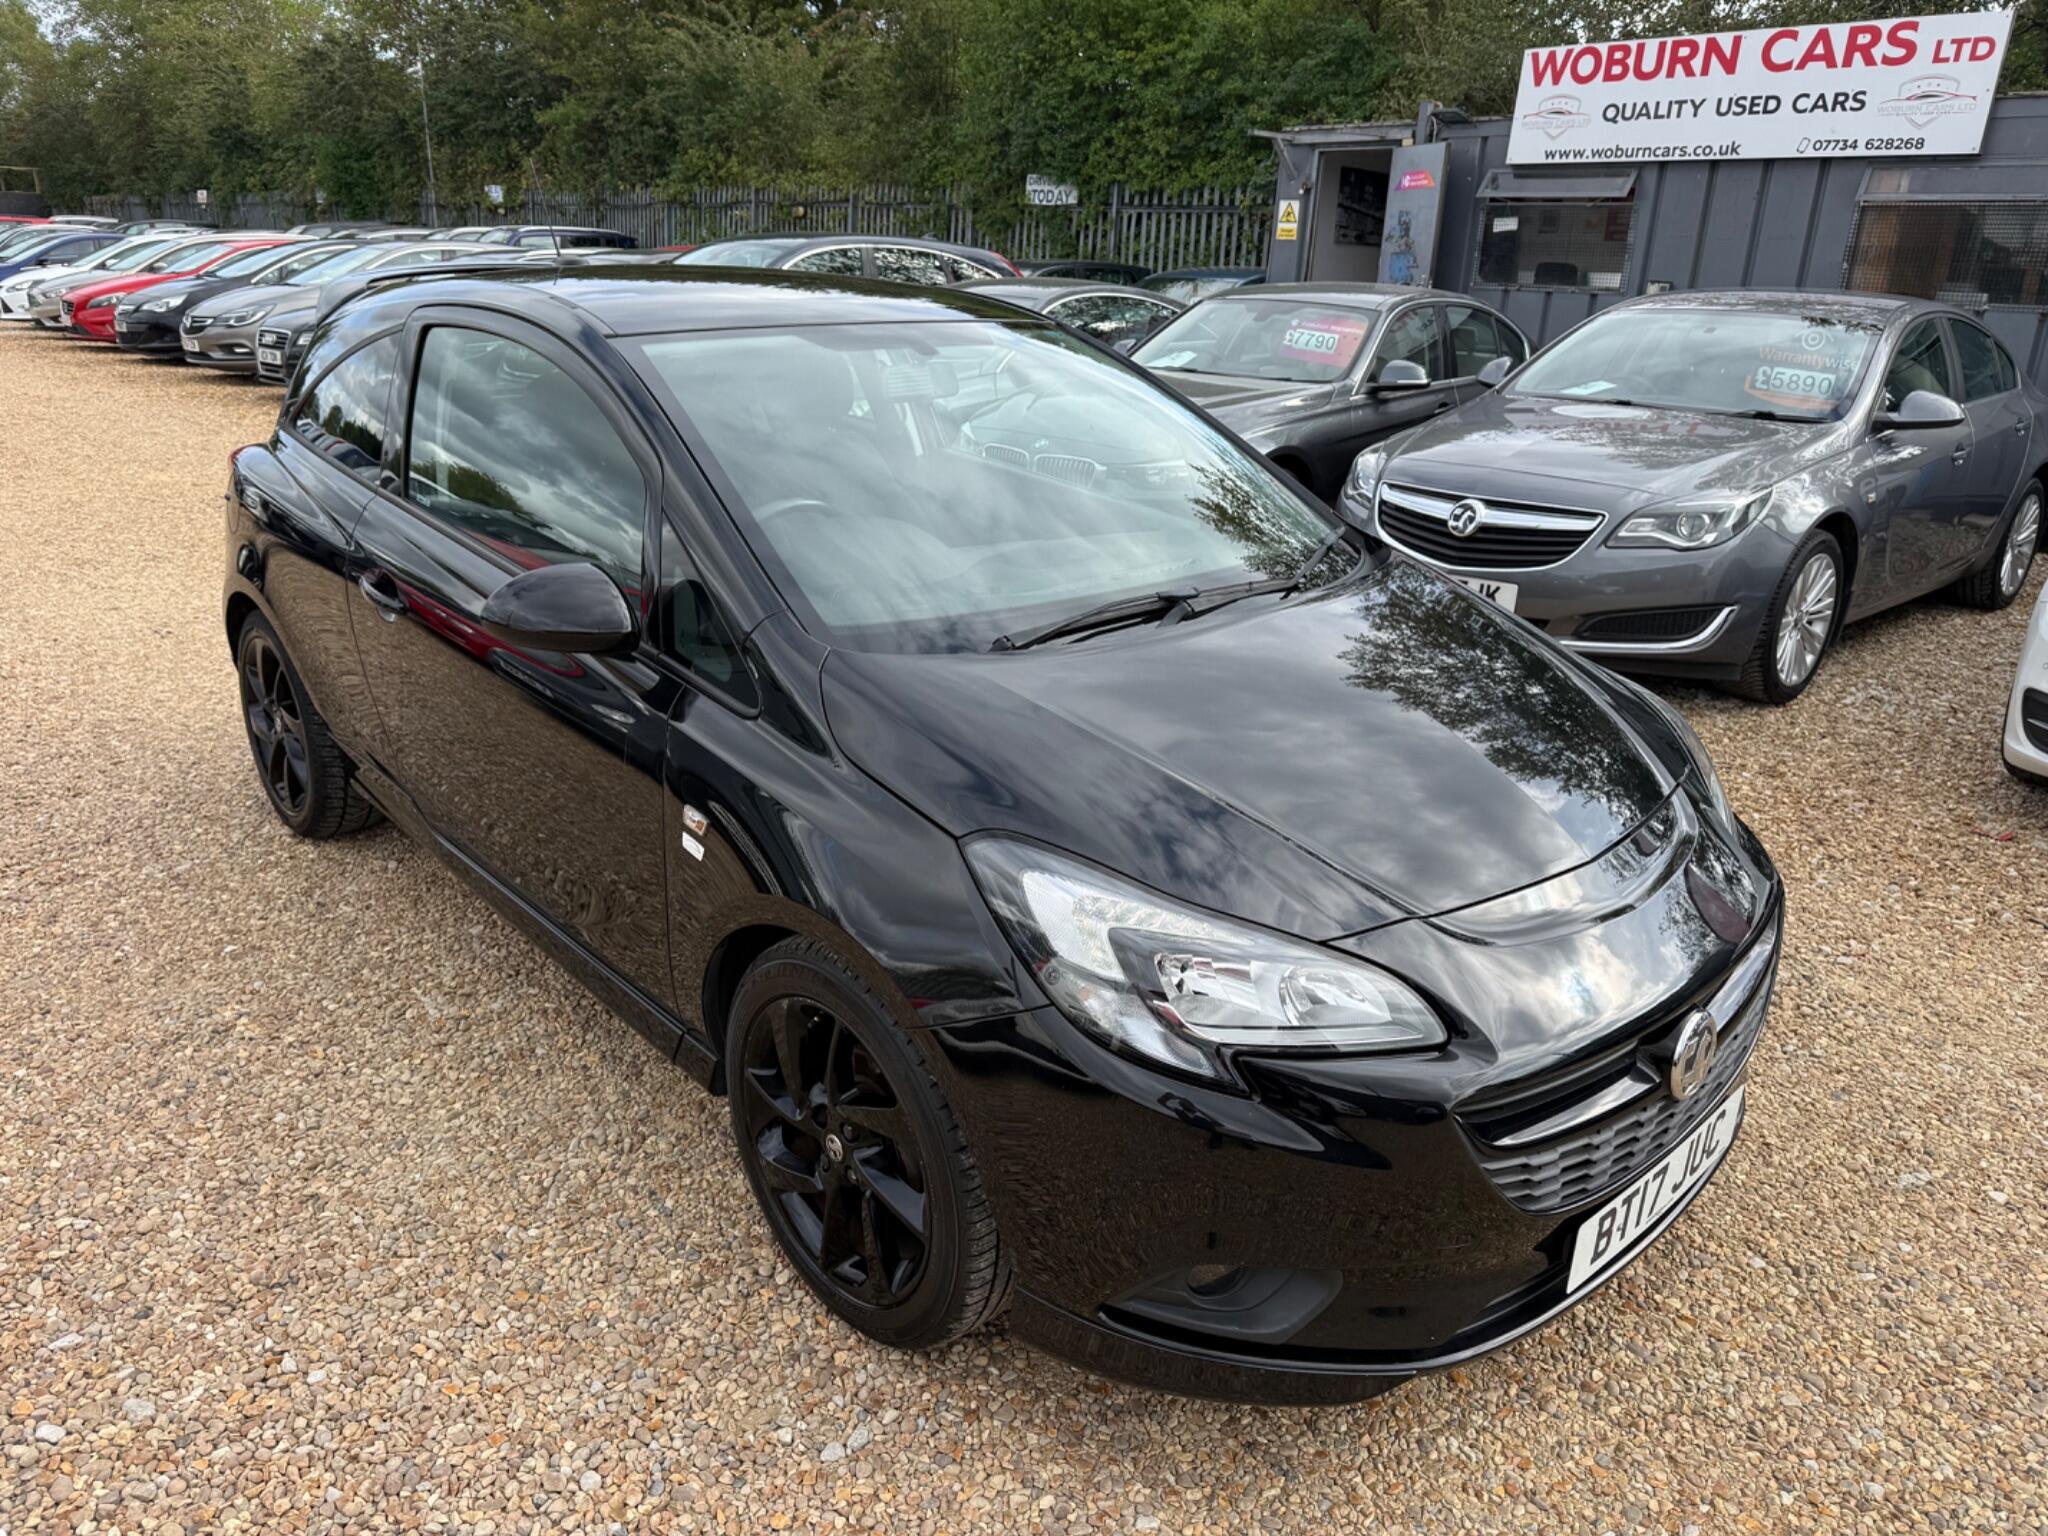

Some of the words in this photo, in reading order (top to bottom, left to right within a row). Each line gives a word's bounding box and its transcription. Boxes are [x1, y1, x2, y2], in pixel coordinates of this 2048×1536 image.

[1530, 35, 1742, 88] WOBURN
[1760, 20, 1920, 73] CARS
[1931, 36, 1996, 64] LTD
[1602, 98, 1707, 124] QUALITY
[1715, 96, 1782, 116] USED
[1791, 90, 1867, 113] CARS
[1544, 140, 1741, 160] www.woburncars.co.uk
[1812, 139, 1858, 153] 07734
[1864, 137, 1925, 152] 628268
[1031, 189, 1073, 204] TODAY
[1283, 329, 1337, 351] £7790
[1754, 365, 1834, 395] £5890
[1590, 1161, 1670, 1265] BT17
[1671, 1109, 1727, 1194] JUC
